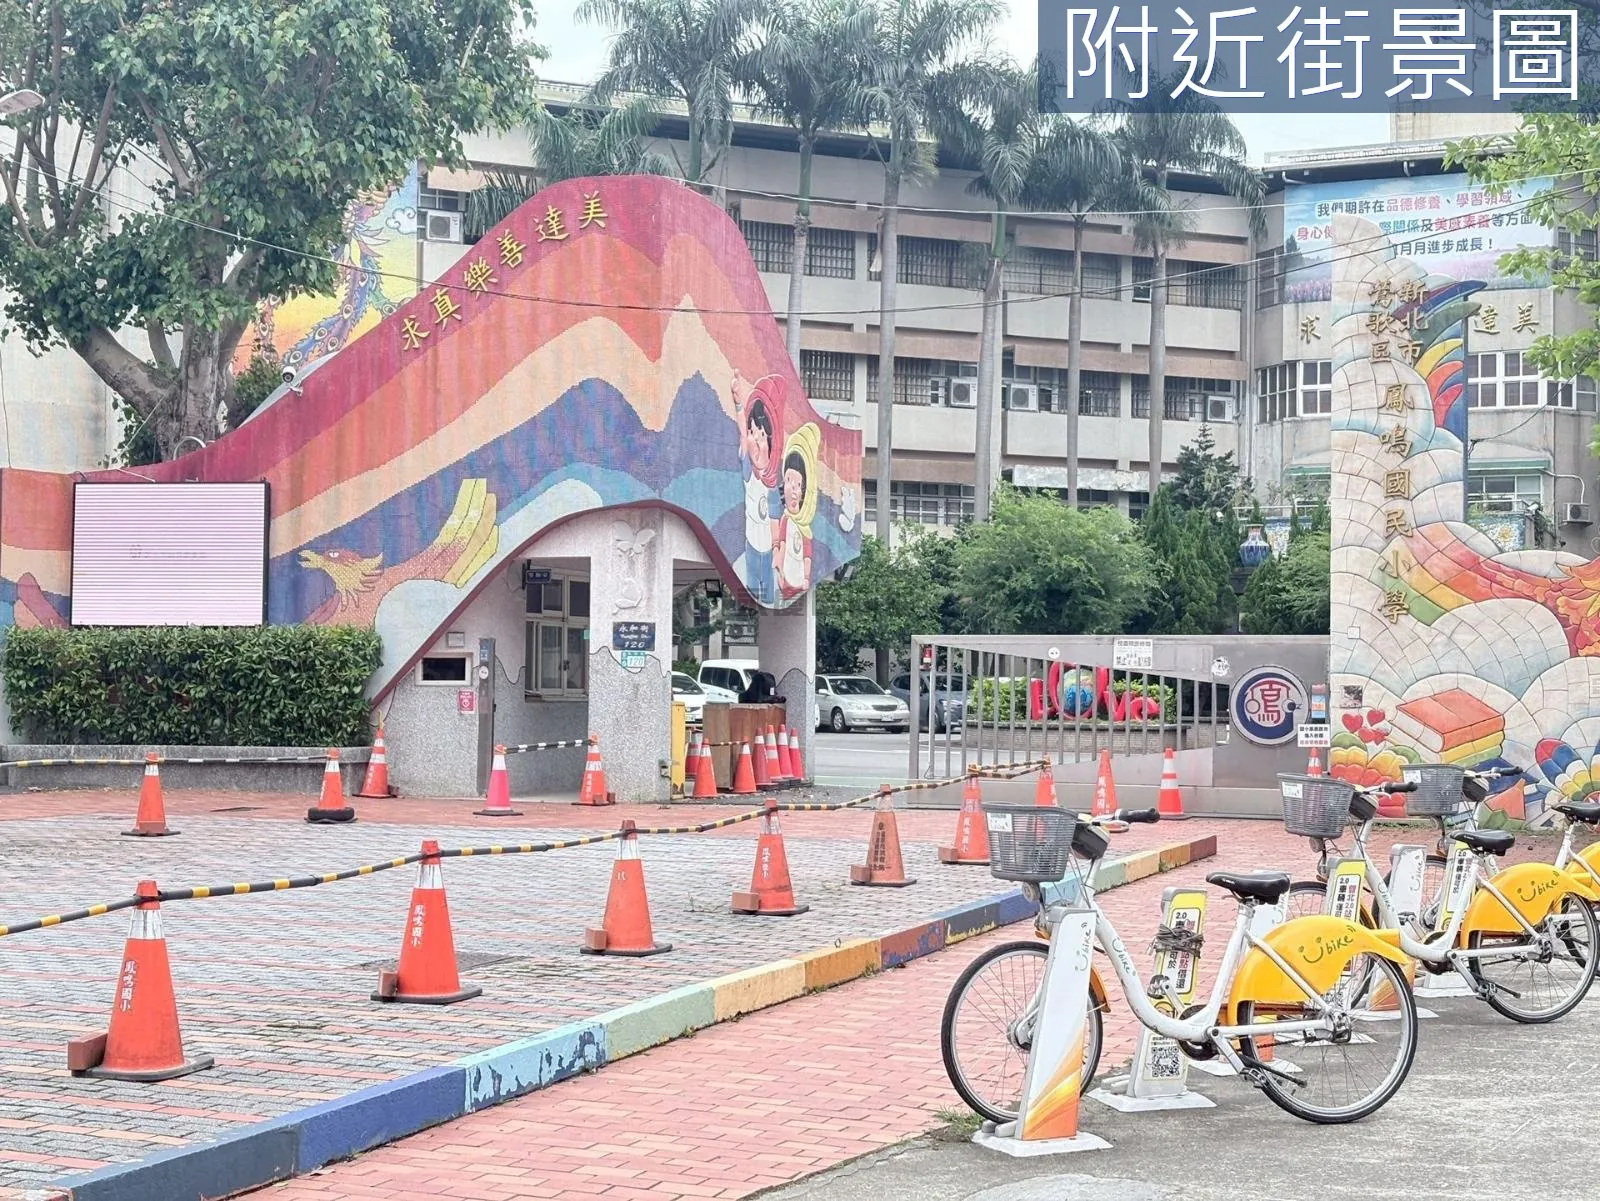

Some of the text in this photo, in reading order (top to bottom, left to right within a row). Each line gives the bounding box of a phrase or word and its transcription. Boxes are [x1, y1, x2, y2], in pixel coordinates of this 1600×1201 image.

[402, 190, 609, 351] 求真樂善達美
[1396, 282, 1430, 368] 新北市
[1378, 383, 1415, 625] 鳳鳴國民小學
[624, 641, 646, 649] 120
[411, 904, 426, 947] 鳳鳴國小
[120, 960, 137, 1012] 鳳鳴國小
